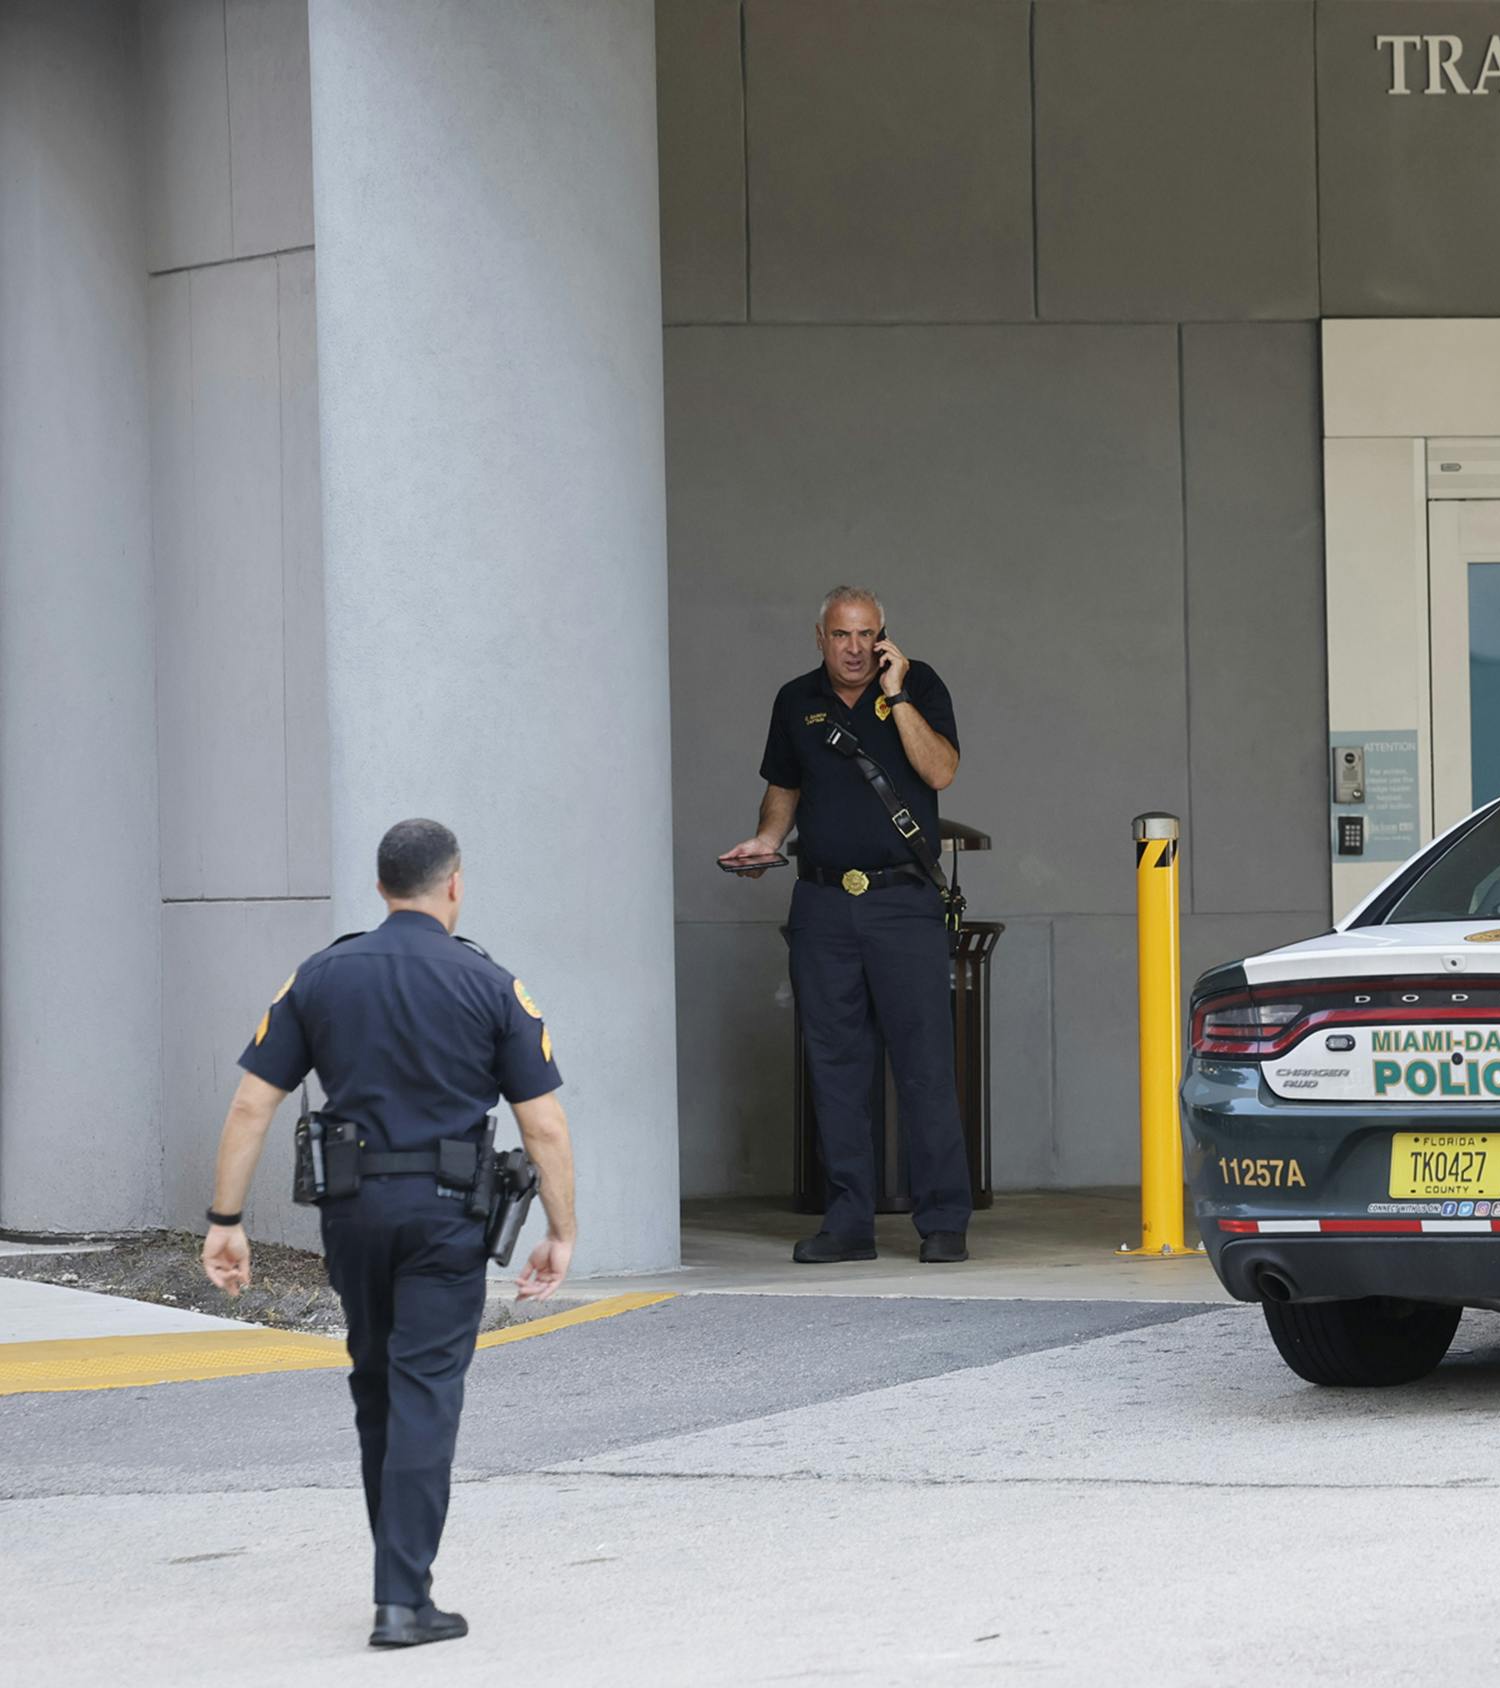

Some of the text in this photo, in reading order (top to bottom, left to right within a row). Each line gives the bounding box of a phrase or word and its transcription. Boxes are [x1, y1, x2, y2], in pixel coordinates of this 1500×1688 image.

[1364, 741, 1416, 752] ATTENTION
[1275, 1067, 1351, 1078] CHARGER
[1282, 1079, 1319, 1089] AWD
[1423, 1136, 1476, 1147] FLORIDA
[1218, 1157, 1308, 1188] 11257A
[1410, 1151, 1487, 1183] TK0427
[1424, 1185, 1470, 1195] COUNTY
